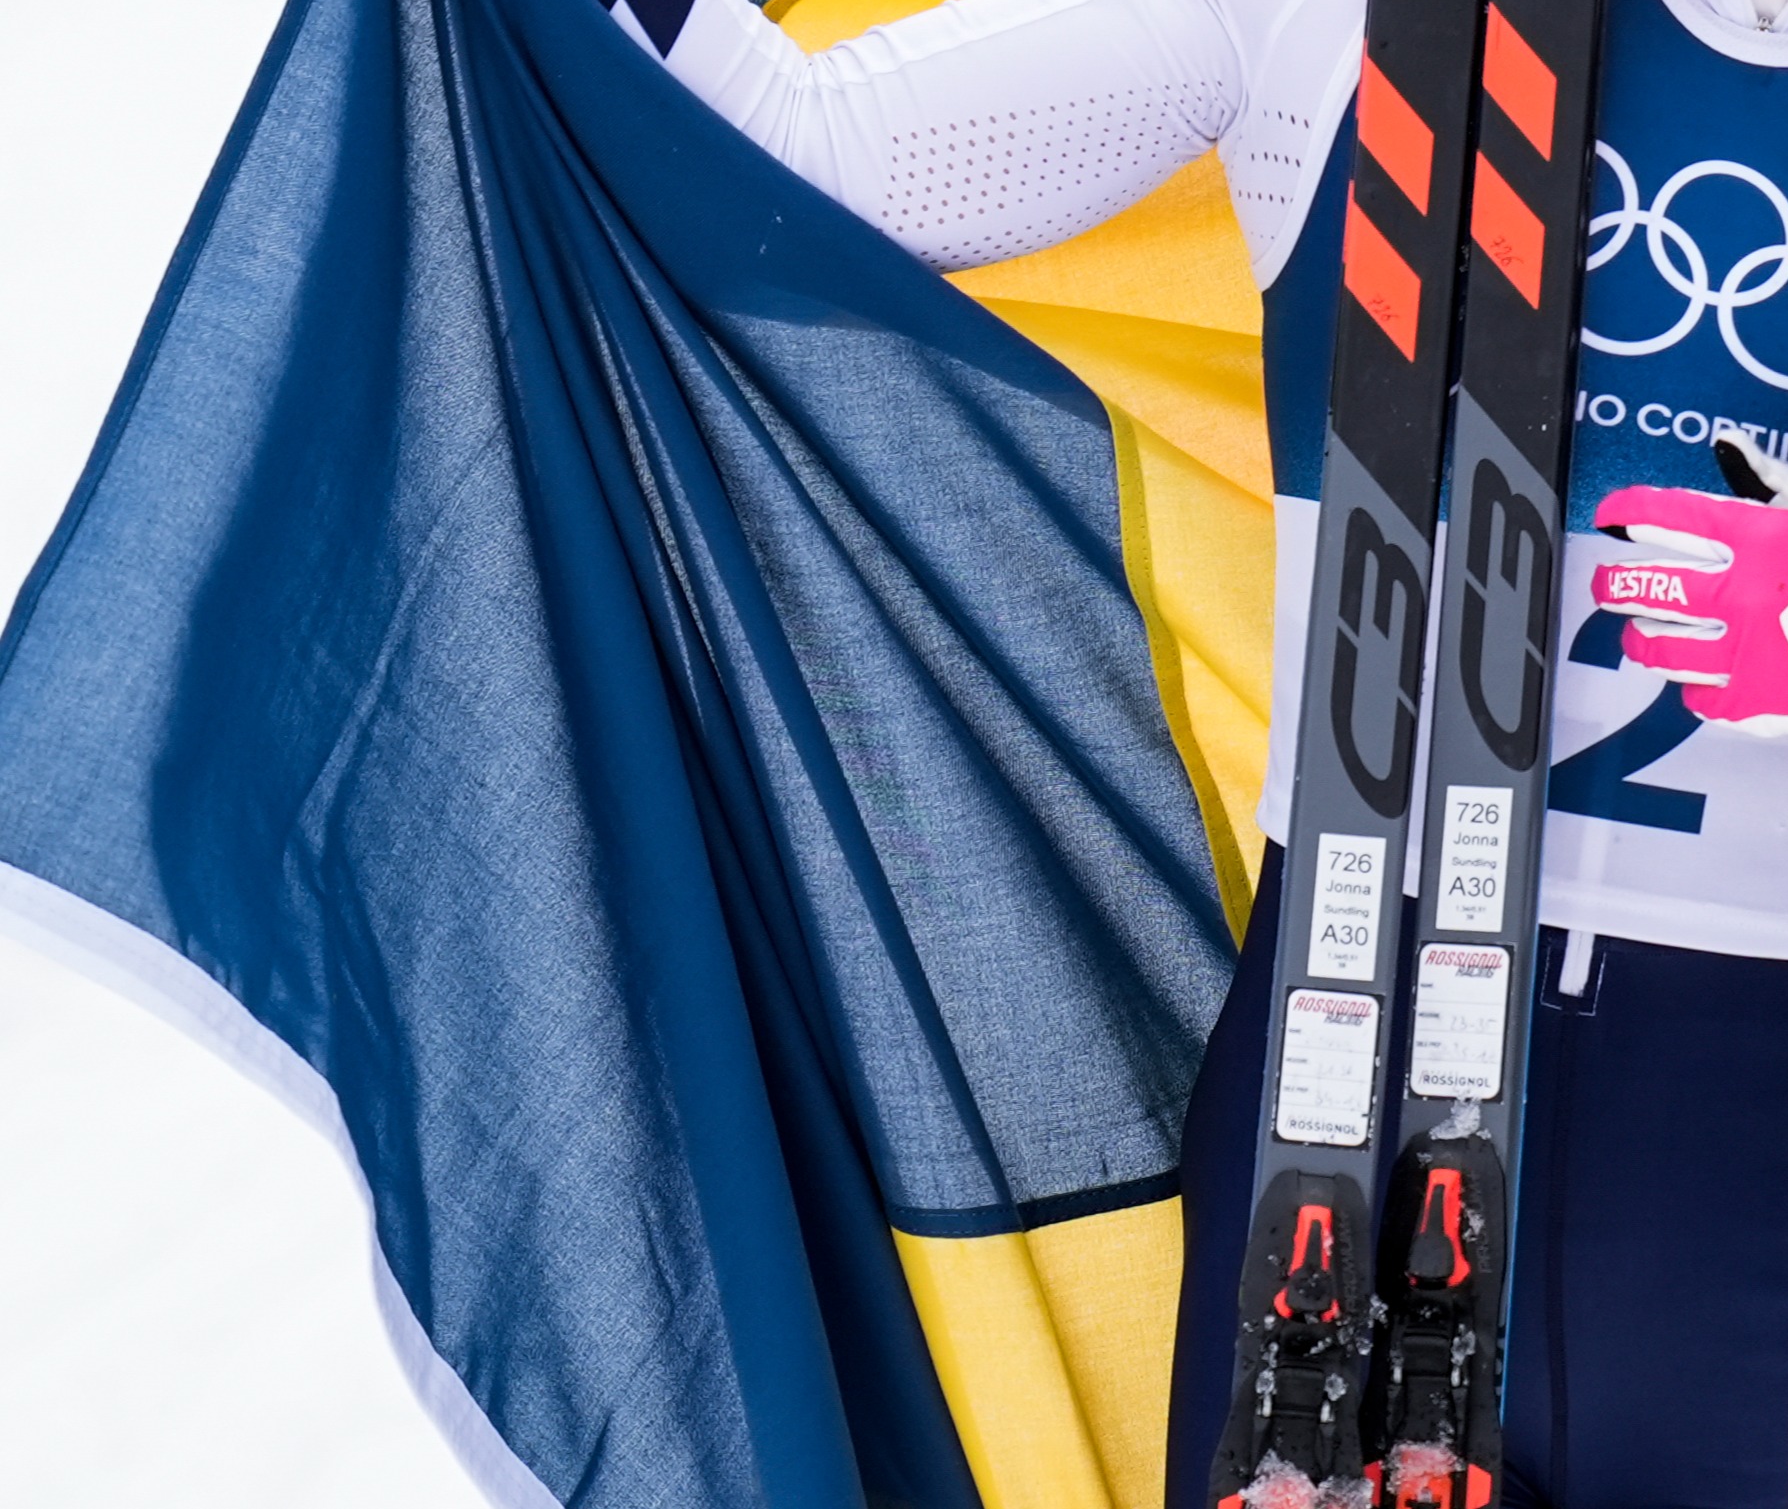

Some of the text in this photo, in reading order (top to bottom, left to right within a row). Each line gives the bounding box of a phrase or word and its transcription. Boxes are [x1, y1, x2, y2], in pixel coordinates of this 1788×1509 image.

[1608, 570, 1689, 606] HESTRA
[1549, 610, 1707, 835] 2
[1456, 802, 1500, 824] 726
[1453, 832, 1499, 847] Jonna
[1328, 851, 1373, 874] 726
[1452, 856, 1498, 871] Sundling
[1325, 879, 1372, 896] Jonna
[1449, 877, 1497, 899] A30
[1324, 904, 1370, 919] Sundling
[1321, 925, 1369, 947] A30
[1425, 950, 1502, 970] ROSSIGNOL
[1293, 996, 1372, 1017] ROSSIGNOL
[1423, 1074, 1491, 1089] ROSSIGNOL
[1289, 1118, 1360, 1136] ROSSIGNOL
